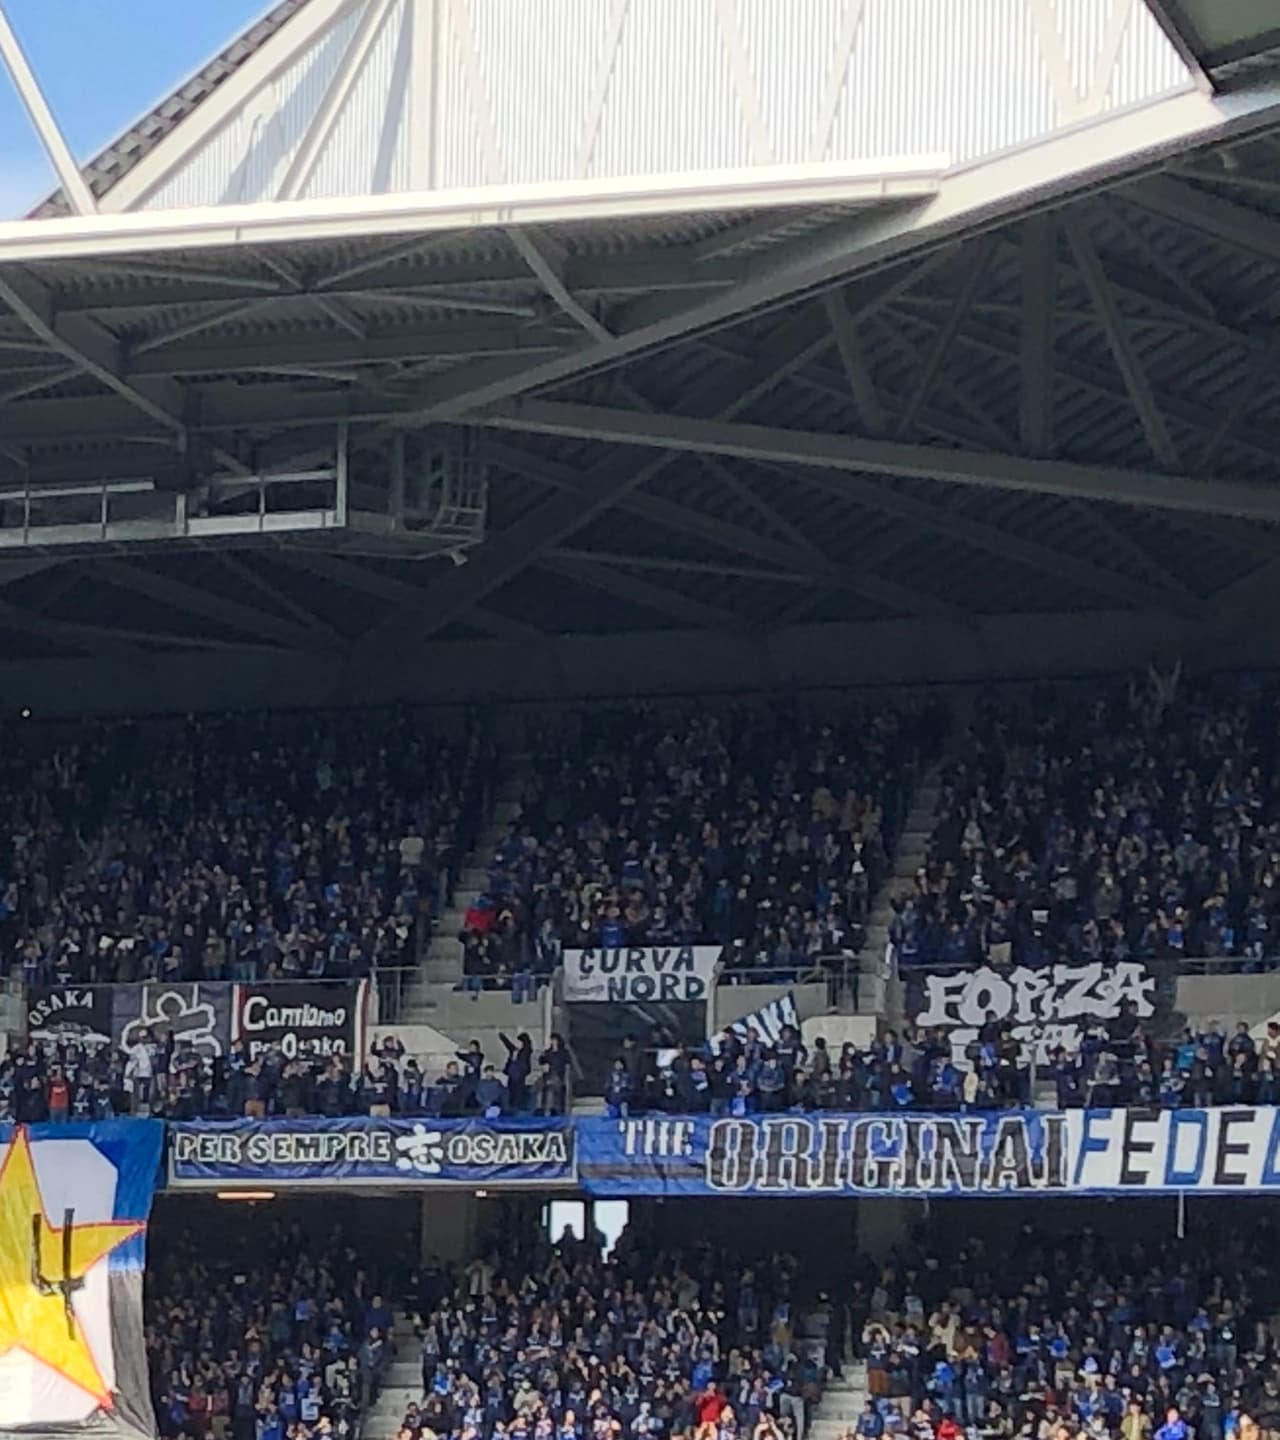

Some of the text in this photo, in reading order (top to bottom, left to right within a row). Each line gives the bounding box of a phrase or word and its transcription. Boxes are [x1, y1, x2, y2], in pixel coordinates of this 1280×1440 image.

[579, 948, 695, 974] CURVA
[607, 973, 706, 1001] NORD
[916, 961, 1156, 1027] FORZA
[28, 989, 94, 1027] OSAKA
[175, 1132, 242, 1163] PER
[248, 1131, 391, 1163] SEMPRE
[447, 1132, 568, 1165] OSAKA
[618, 1119, 695, 1157] THE
